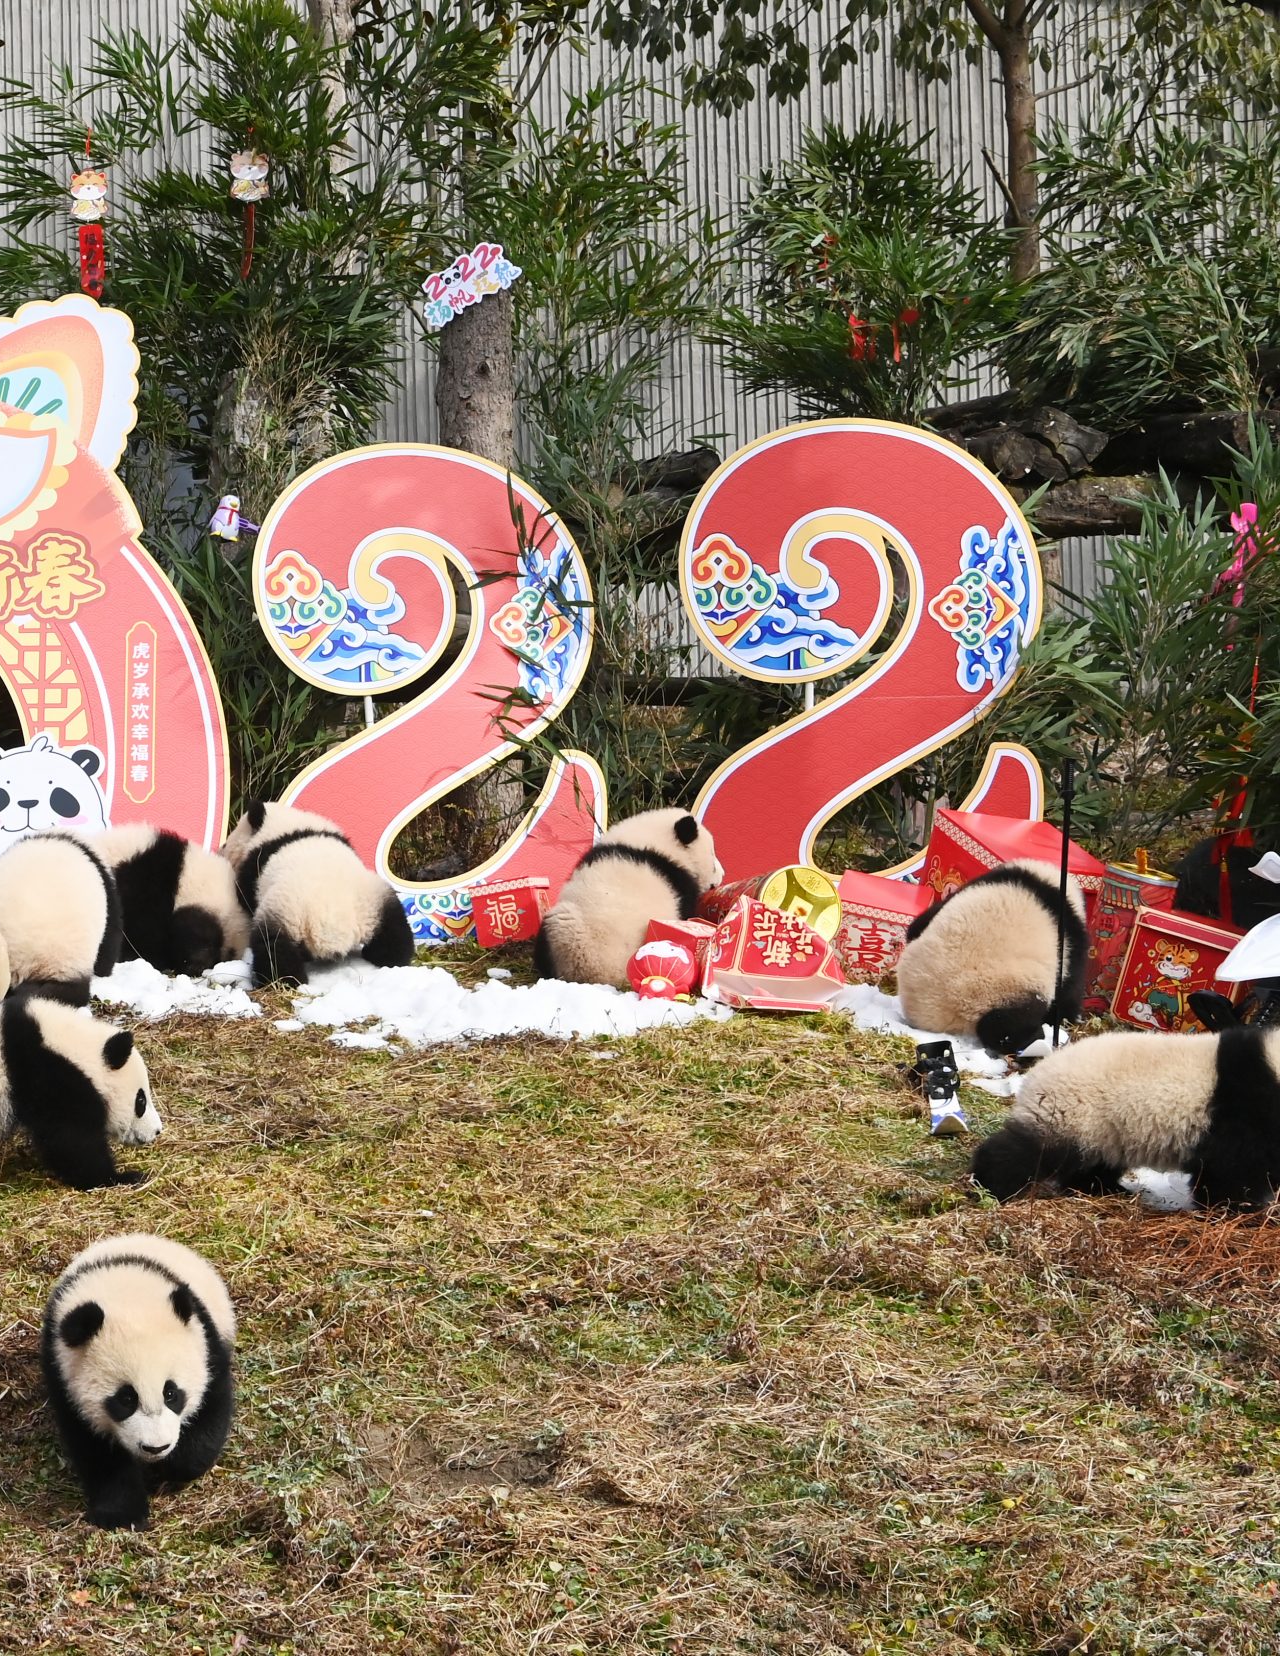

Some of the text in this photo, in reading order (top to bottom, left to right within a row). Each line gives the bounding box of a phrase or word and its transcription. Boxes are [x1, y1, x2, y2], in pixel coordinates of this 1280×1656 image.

[130, 642, 151, 782] 虎岁承欢幸福春
[486, 894, 520, 935] 福
